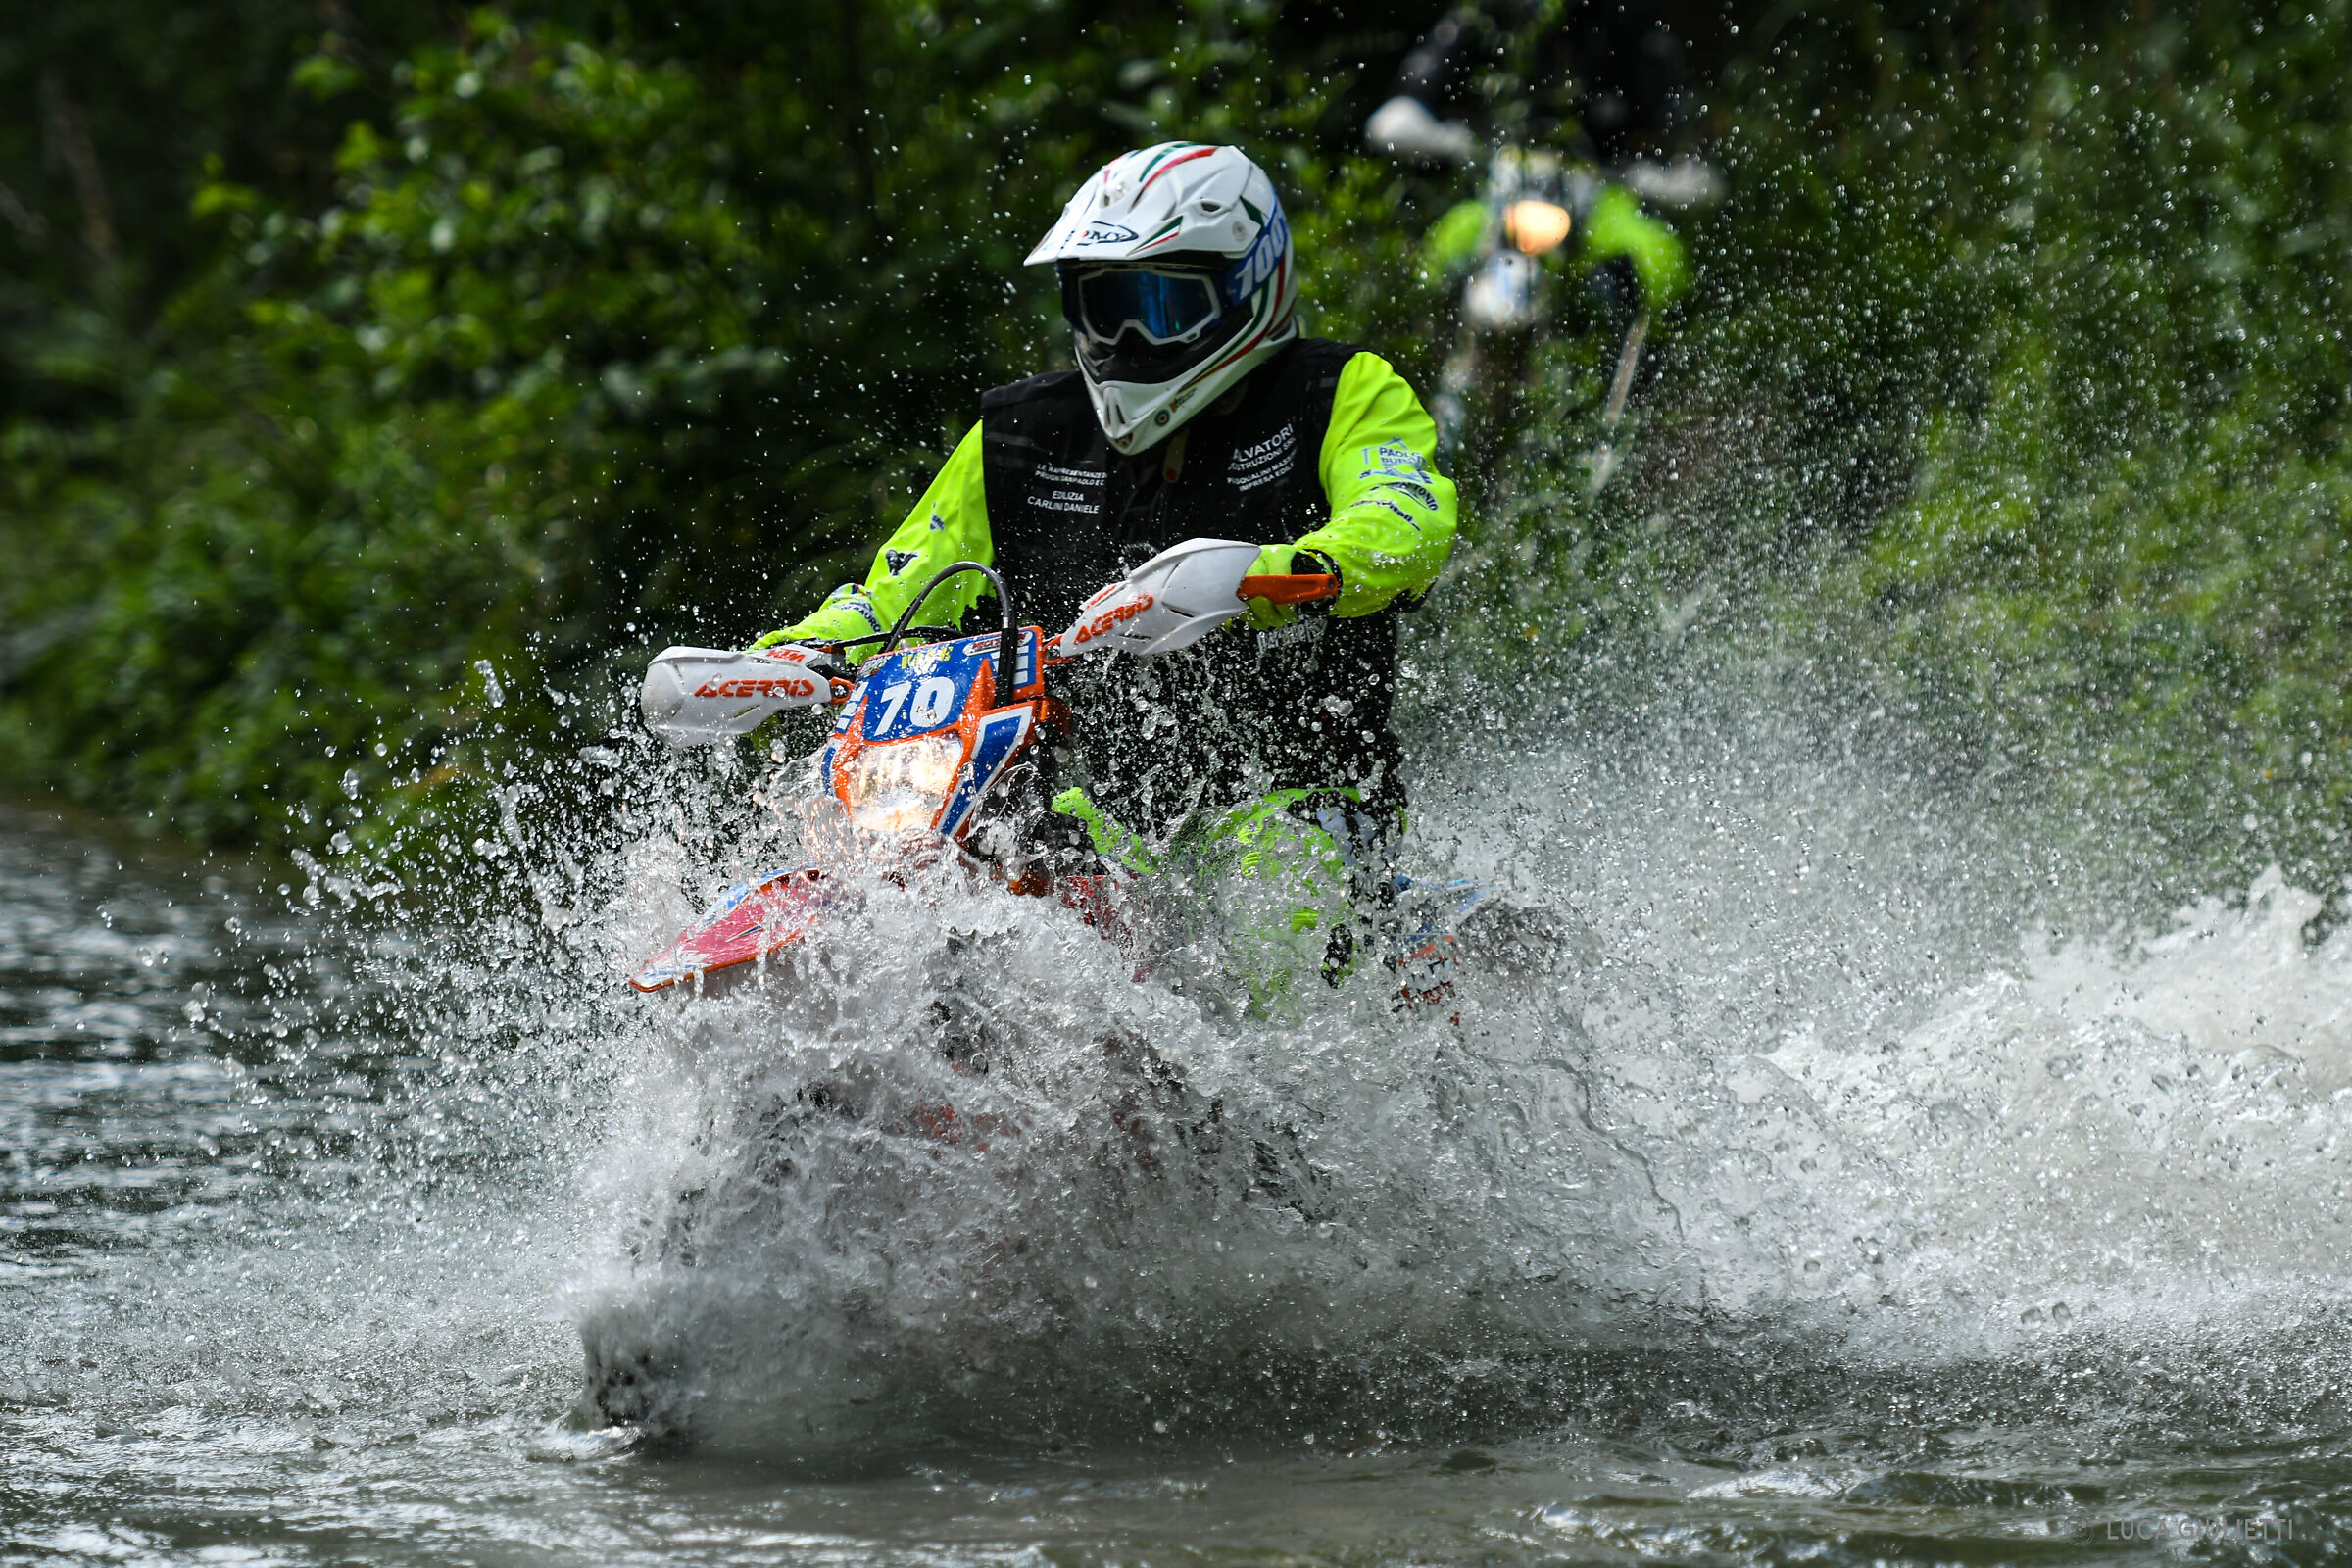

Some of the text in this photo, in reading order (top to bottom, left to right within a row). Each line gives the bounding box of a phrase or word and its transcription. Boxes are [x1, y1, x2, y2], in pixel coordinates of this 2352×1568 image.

[766, 648, 807, 662] KTM
[694, 678, 815, 698] ACERBIS
[873, 676, 956, 737] 70
